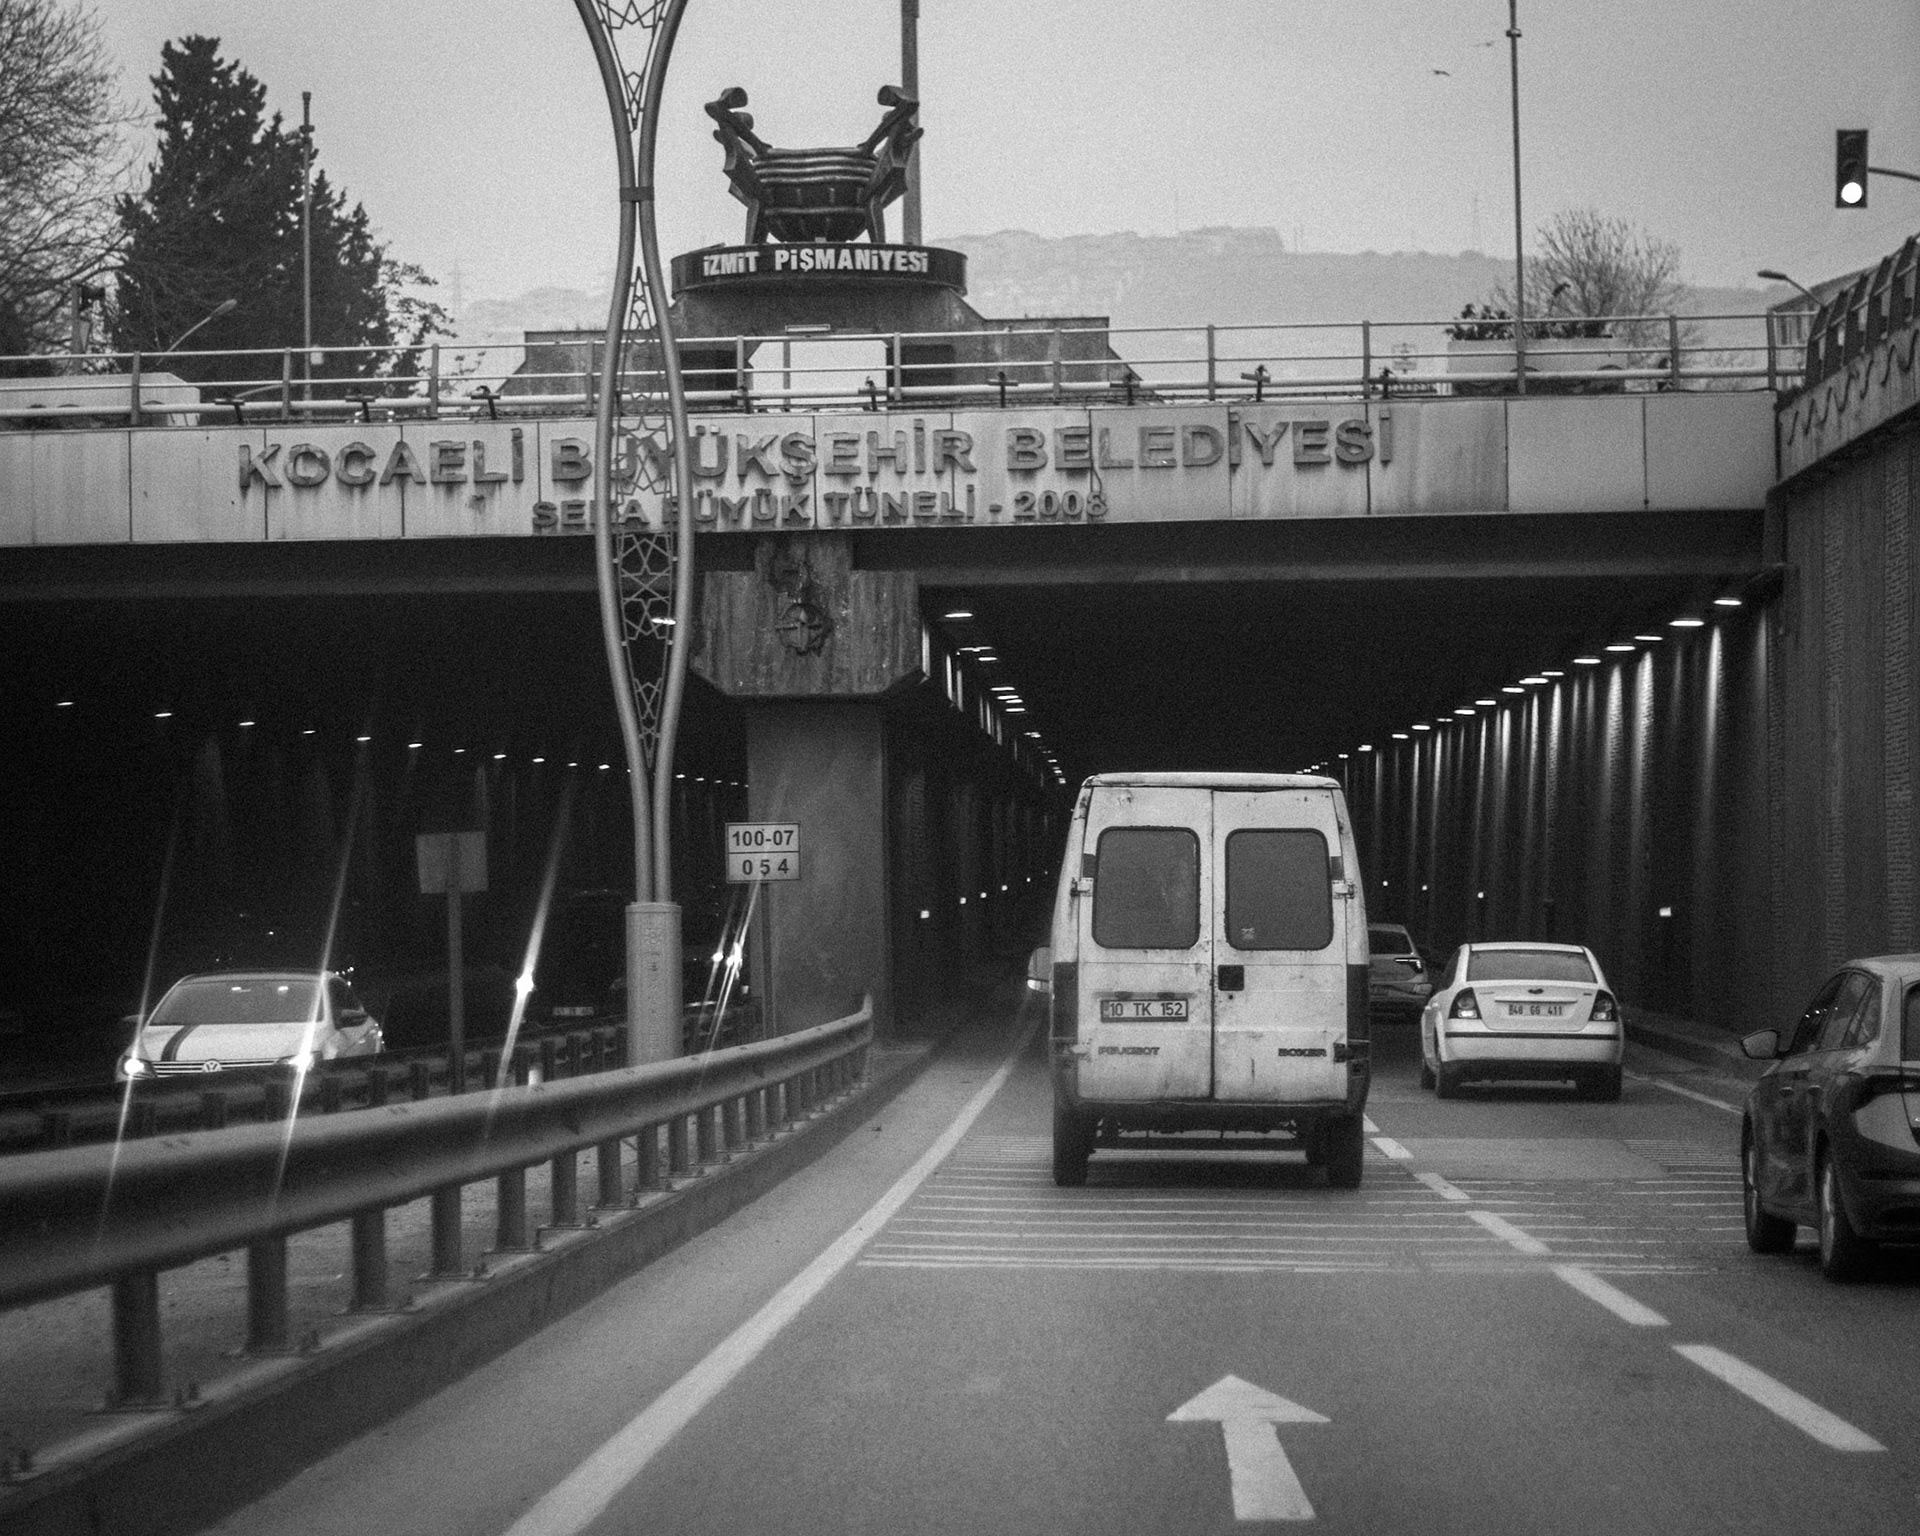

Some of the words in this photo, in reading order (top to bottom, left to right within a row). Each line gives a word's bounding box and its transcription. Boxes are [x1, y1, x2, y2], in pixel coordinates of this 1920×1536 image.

[239, 427, 525, 488] KOCAELİ
[1005, 409, 1392, 472] BELEDİYESİ
[823, 484, 975, 520] TÜNELİ
[1014, 490, 1107, 518] 2008
[732, 830, 794, 846] 100-07
[1110, 1002, 1123, 1016] 10
[1133, 1002, 1152, 1016] TK
[1160, 1002, 1183, 1016] 152
